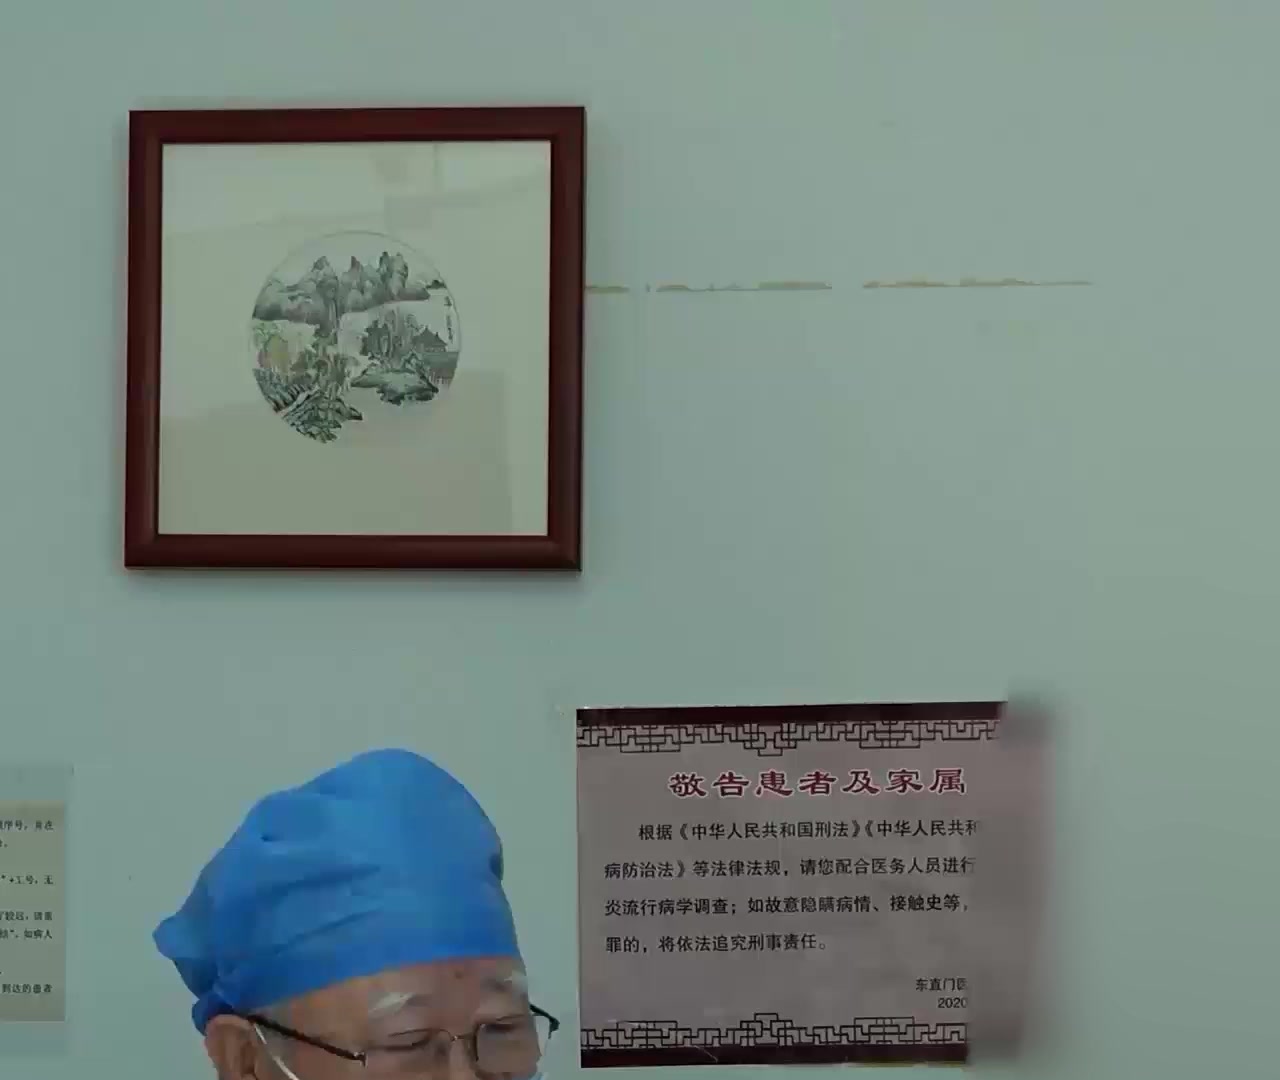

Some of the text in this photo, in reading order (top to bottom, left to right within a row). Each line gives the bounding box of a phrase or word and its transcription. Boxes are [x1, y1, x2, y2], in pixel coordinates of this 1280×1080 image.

[668, 767, 967, 799] 敬告患者及家属
[605, 932, 827, 954] 罪的，将依法追究刑事责任。
[937, 997, 967, 1009] 2020
